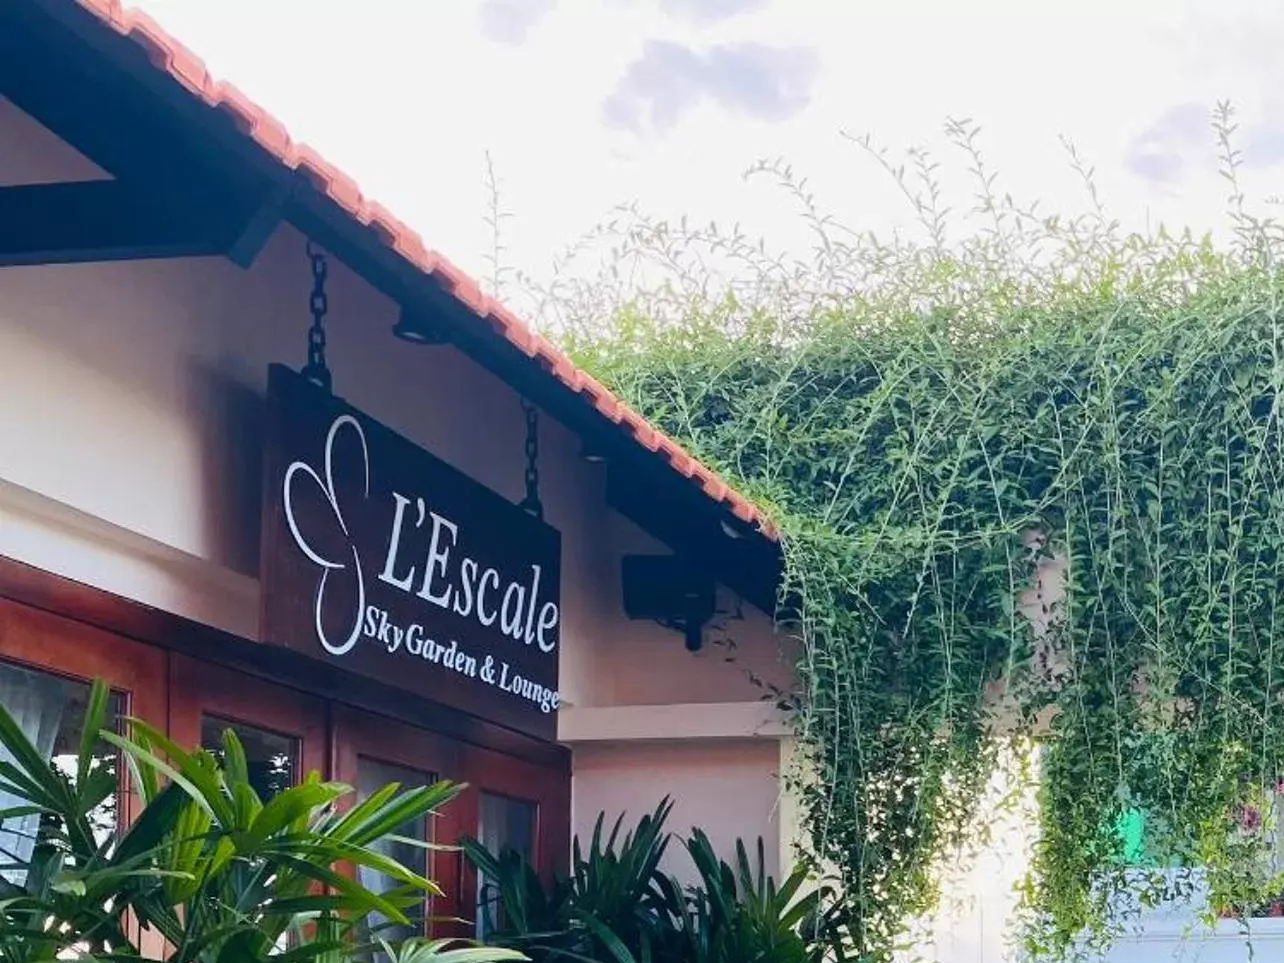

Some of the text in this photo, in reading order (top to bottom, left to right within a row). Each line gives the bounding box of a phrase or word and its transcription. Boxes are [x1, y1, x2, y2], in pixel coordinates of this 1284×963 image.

[378, 491, 558, 652] L'Escale
[363, 605, 560, 713] Sky Garden & Lounge
